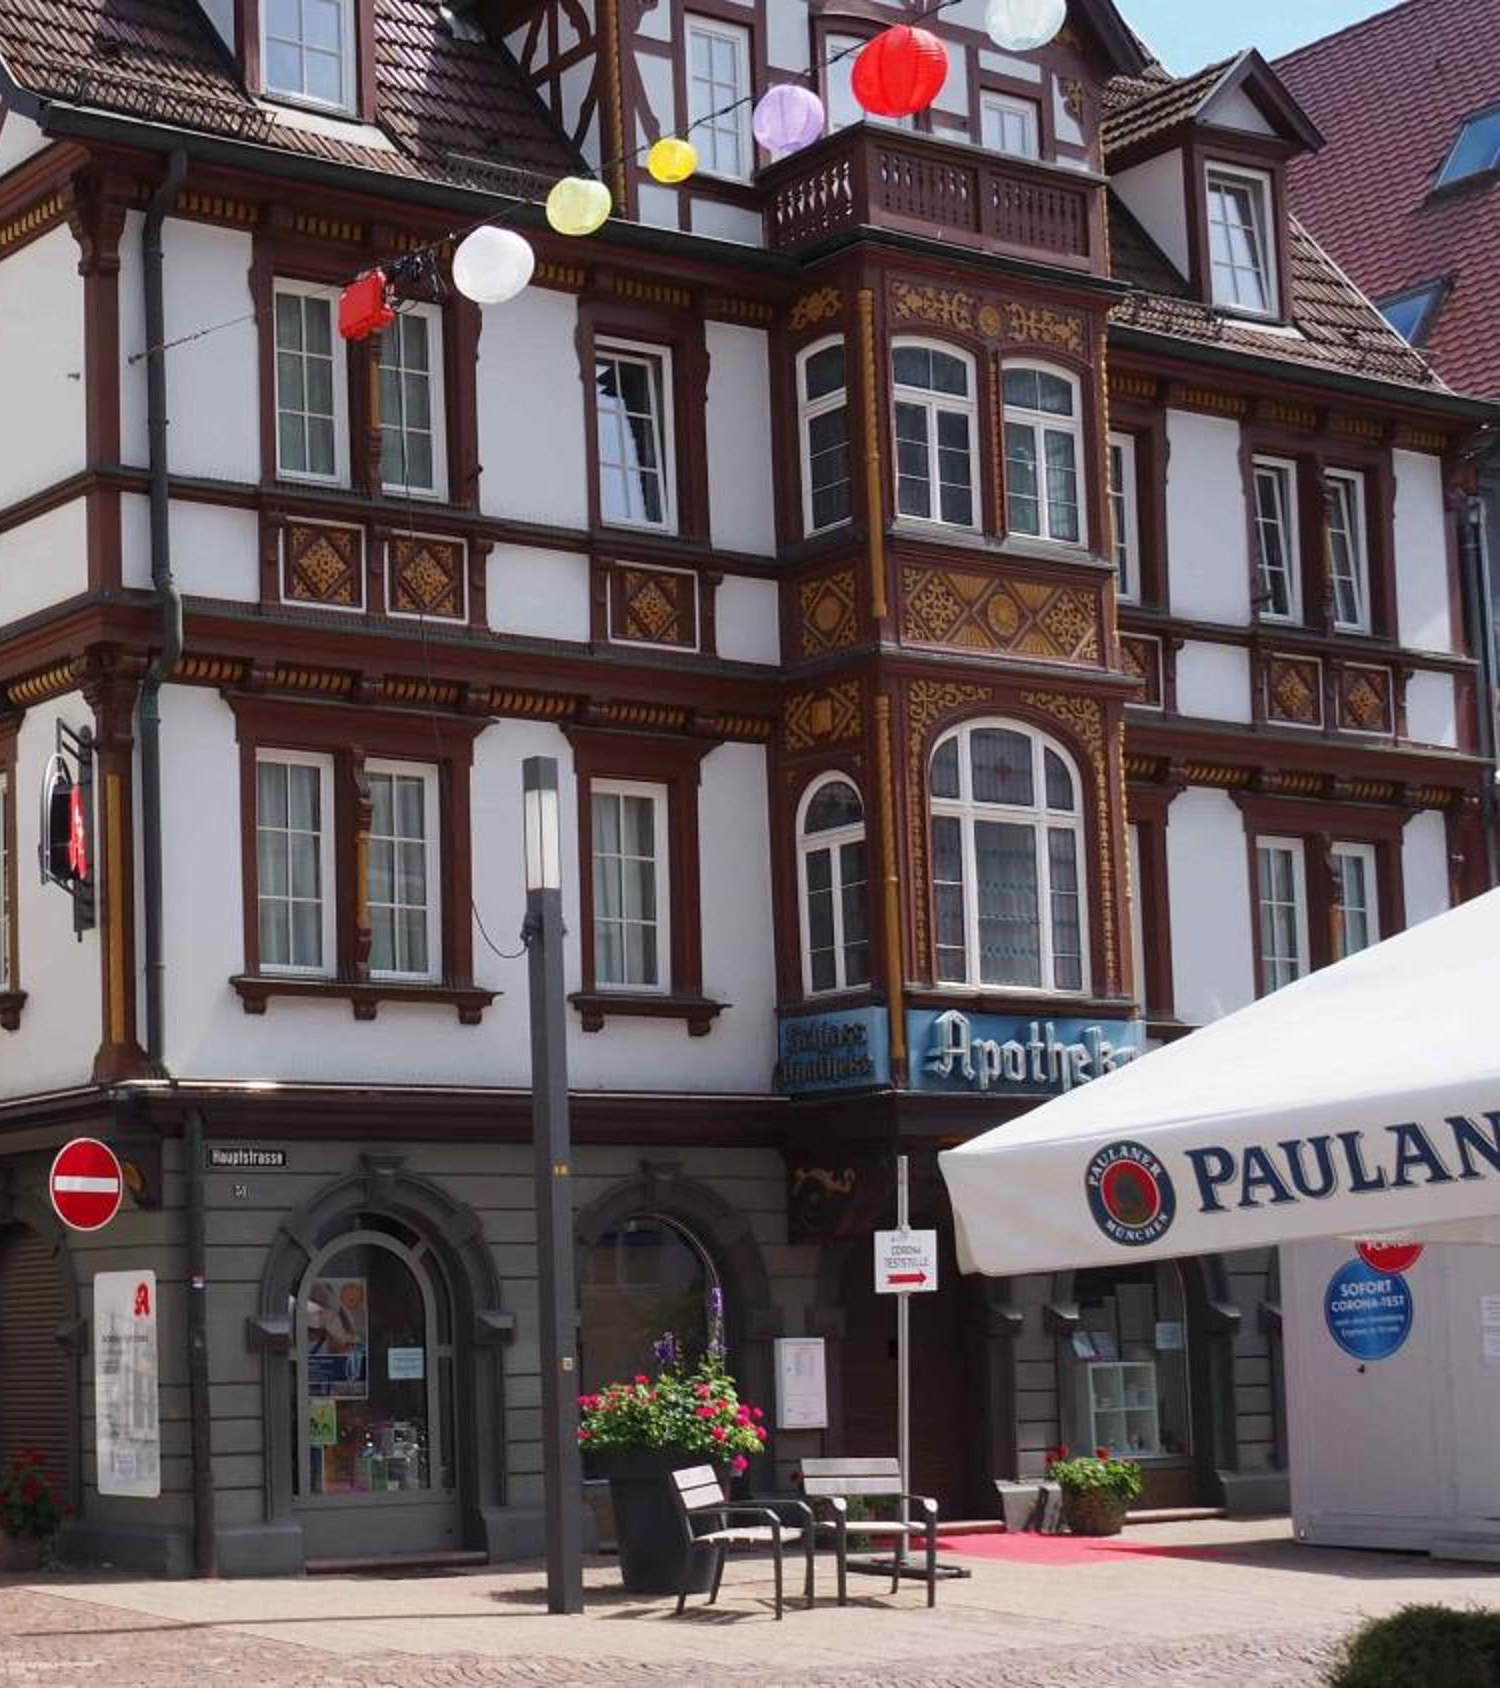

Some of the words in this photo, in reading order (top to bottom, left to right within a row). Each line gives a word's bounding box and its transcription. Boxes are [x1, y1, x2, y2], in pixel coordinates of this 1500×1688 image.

[211, 1149, 283, 1165] Hauptstrasse
[1088, 1145, 1162, 1188] PAULANER
[1340, 1279, 1392, 1297] SOFORT
[1331, 1295, 1405, 1313] CORONA-TEST
